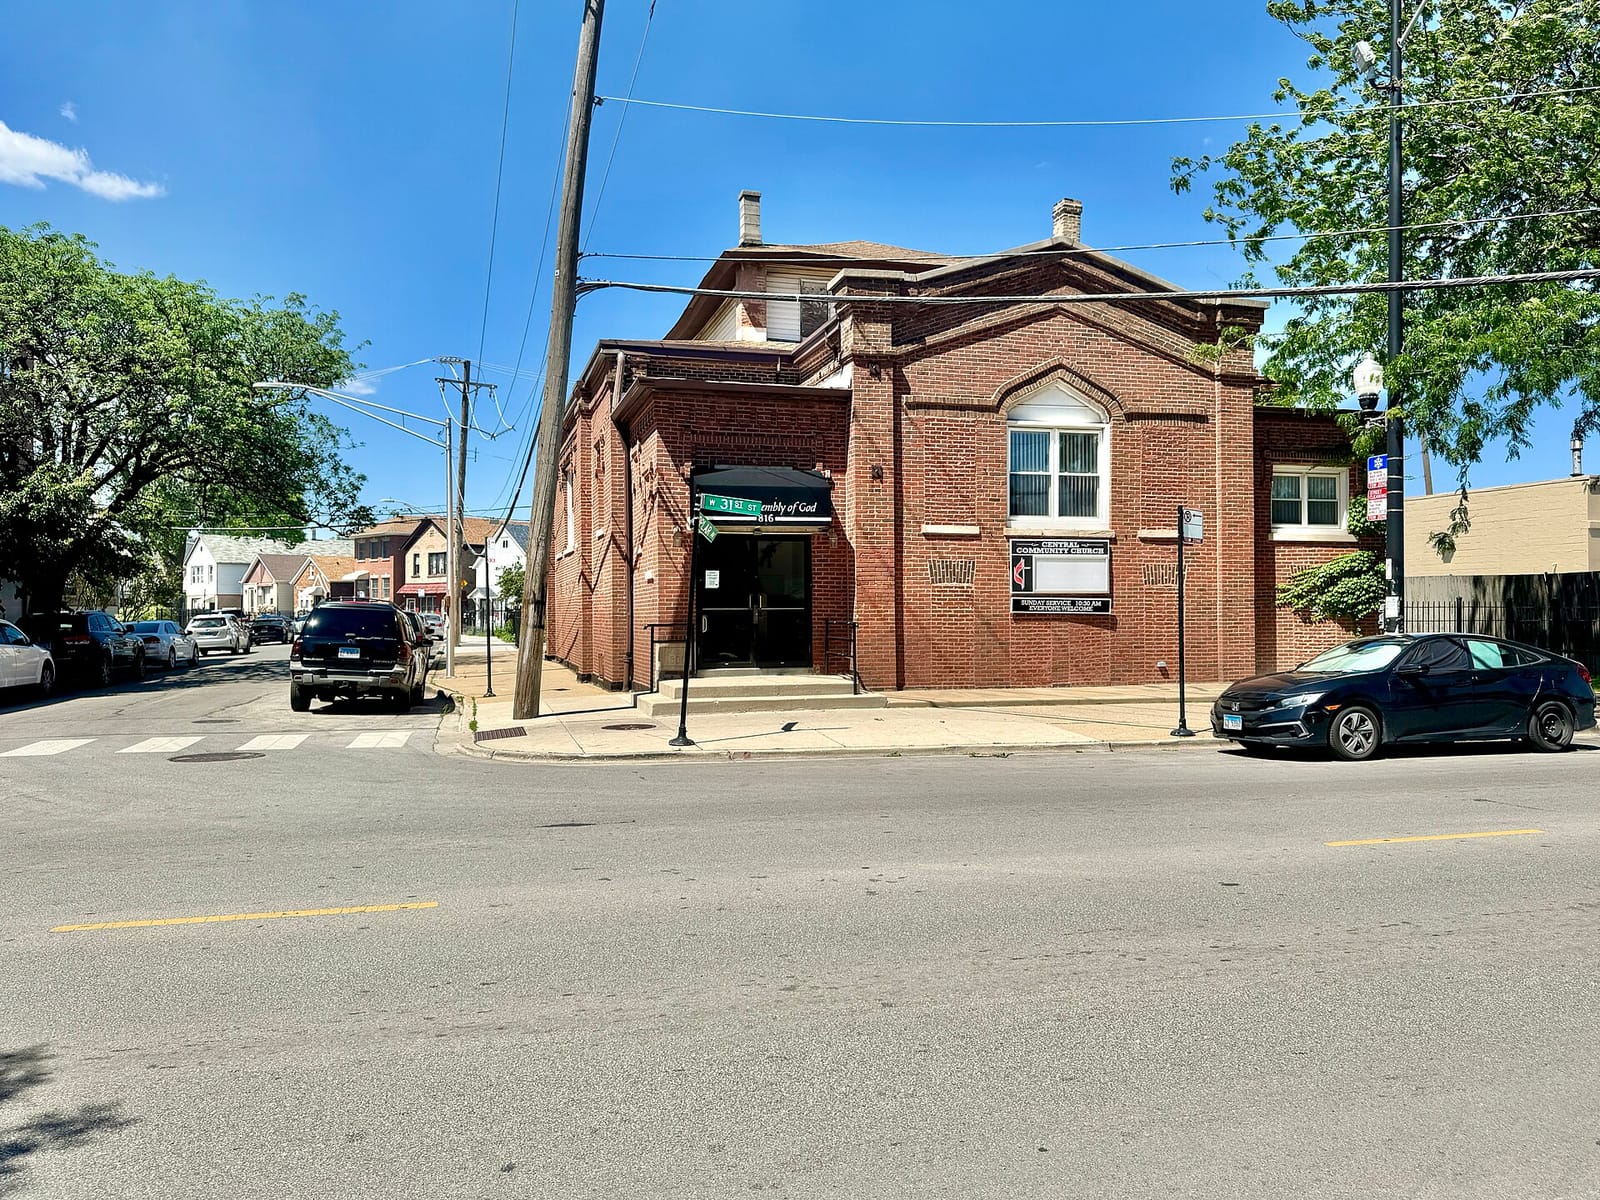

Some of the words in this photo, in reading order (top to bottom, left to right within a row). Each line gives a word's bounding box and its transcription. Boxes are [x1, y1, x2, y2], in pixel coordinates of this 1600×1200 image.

[787, 501, 799, 515] of
[798, 502, 817, 512] God
[758, 514, 774, 522] 816
